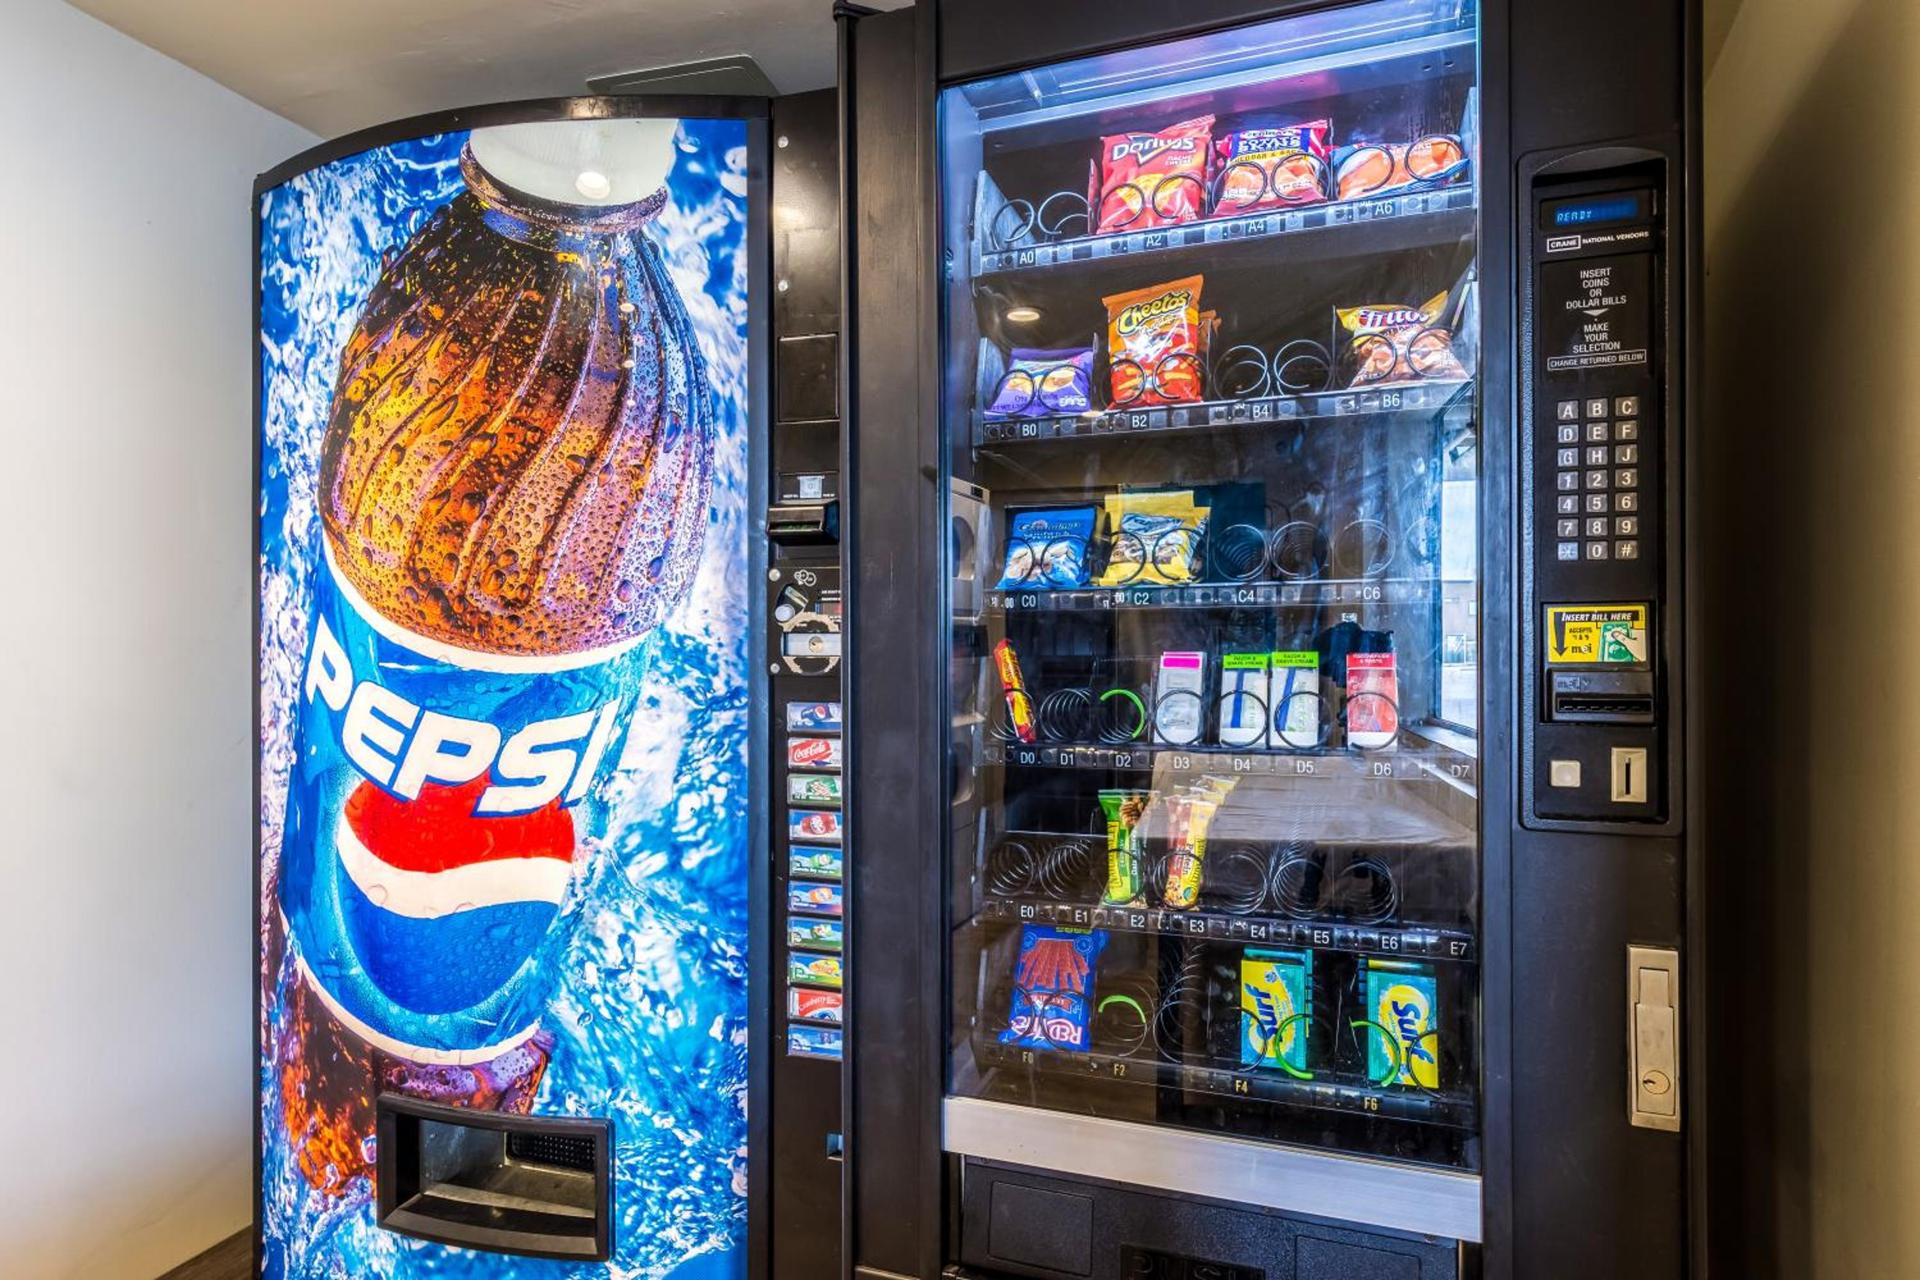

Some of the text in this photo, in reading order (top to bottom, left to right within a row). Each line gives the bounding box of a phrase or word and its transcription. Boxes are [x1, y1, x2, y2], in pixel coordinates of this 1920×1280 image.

[1112, 137, 1196, 161] Doritos
[1375, 202, 1393, 216] A6
[1557, 210, 1592, 222] READY
[1248, 219, 1265, 234] A4
[1146, 235, 1162, 247] A2
[1550, 231, 1649, 248] CRANE NATIONAL VENDORS
[1019, 249, 1035, 265] A0
[1580, 267, 1612, 279] INSERT
[1582, 278, 1610, 288] COINS
[1589, 288, 1602, 298] OR
[1566, 295, 1627, 310] DOLLAR BILLS
[1118, 291, 1190, 334] Cheetos
[1359, 309, 1430, 329] Fritos
[1584, 322, 1609, 332] MAKE
[1584, 332, 1608, 342] YOUR
[1572, 342, 1620, 354] SELECTION
[1550, 352, 1644, 368] CHANGE RETURNED BELOW
[1383, 394, 1400, 408] B6
[1252, 404, 1270, 418] B4
[1563, 400, 1632, 418] A B C
[1132, 414, 1148, 428] B2
[1022, 424, 1037, 436] B0
[1564, 424, 1631, 440] D E F
[1564, 448, 1630, 464] G H J
[1564, 472, 1631, 488] 1 2 3
[1562, 496, 1631, 511] 4 5 6
[1564, 520, 1631, 534] 7 8 9
[1592, 544, 1632, 557] 0 #
[1134, 592, 1150, 606] C2
[1238, 589, 1255, 603] C4
[1363, 586, 1381, 600] C6
[1022, 594, 1036, 608] C0
[1562, 612, 1632, 622] INSERT BILL HERE
[305, 612, 620, 813] PEPSI
[1020, 752, 1035, 764] D0
[1060, 752, 1074, 766] D1
[1116, 755, 1132, 768] D2
[1174, 757, 1190, 769] D3
[1234, 758, 1251, 772] D4
[1296, 760, 1314, 774] D5
[1374, 762, 1392, 776] D6
[1451, 764, 1470, 778] D7
[1020, 906, 1034, 918] E0
[1075, 910, 1088, 922] E1
[1130, 915, 1145, 928] E2
[1190, 920, 1204, 932] E3
[1250, 926, 1266, 939] E4
[1314, 930, 1330, 944] E5
[1381, 936, 1398, 950] E6
[1450, 942, 1467, 956] E7
[1245, 982, 1283, 1042] Surf
[1047, 1018, 1082, 1045] RED
[1392, 1000, 1434, 1064] Surf
[1114, 1064, 1126, 1076] F2
[1235, 1080, 1248, 1093] F4
[1364, 1097, 1378, 1110] F6
